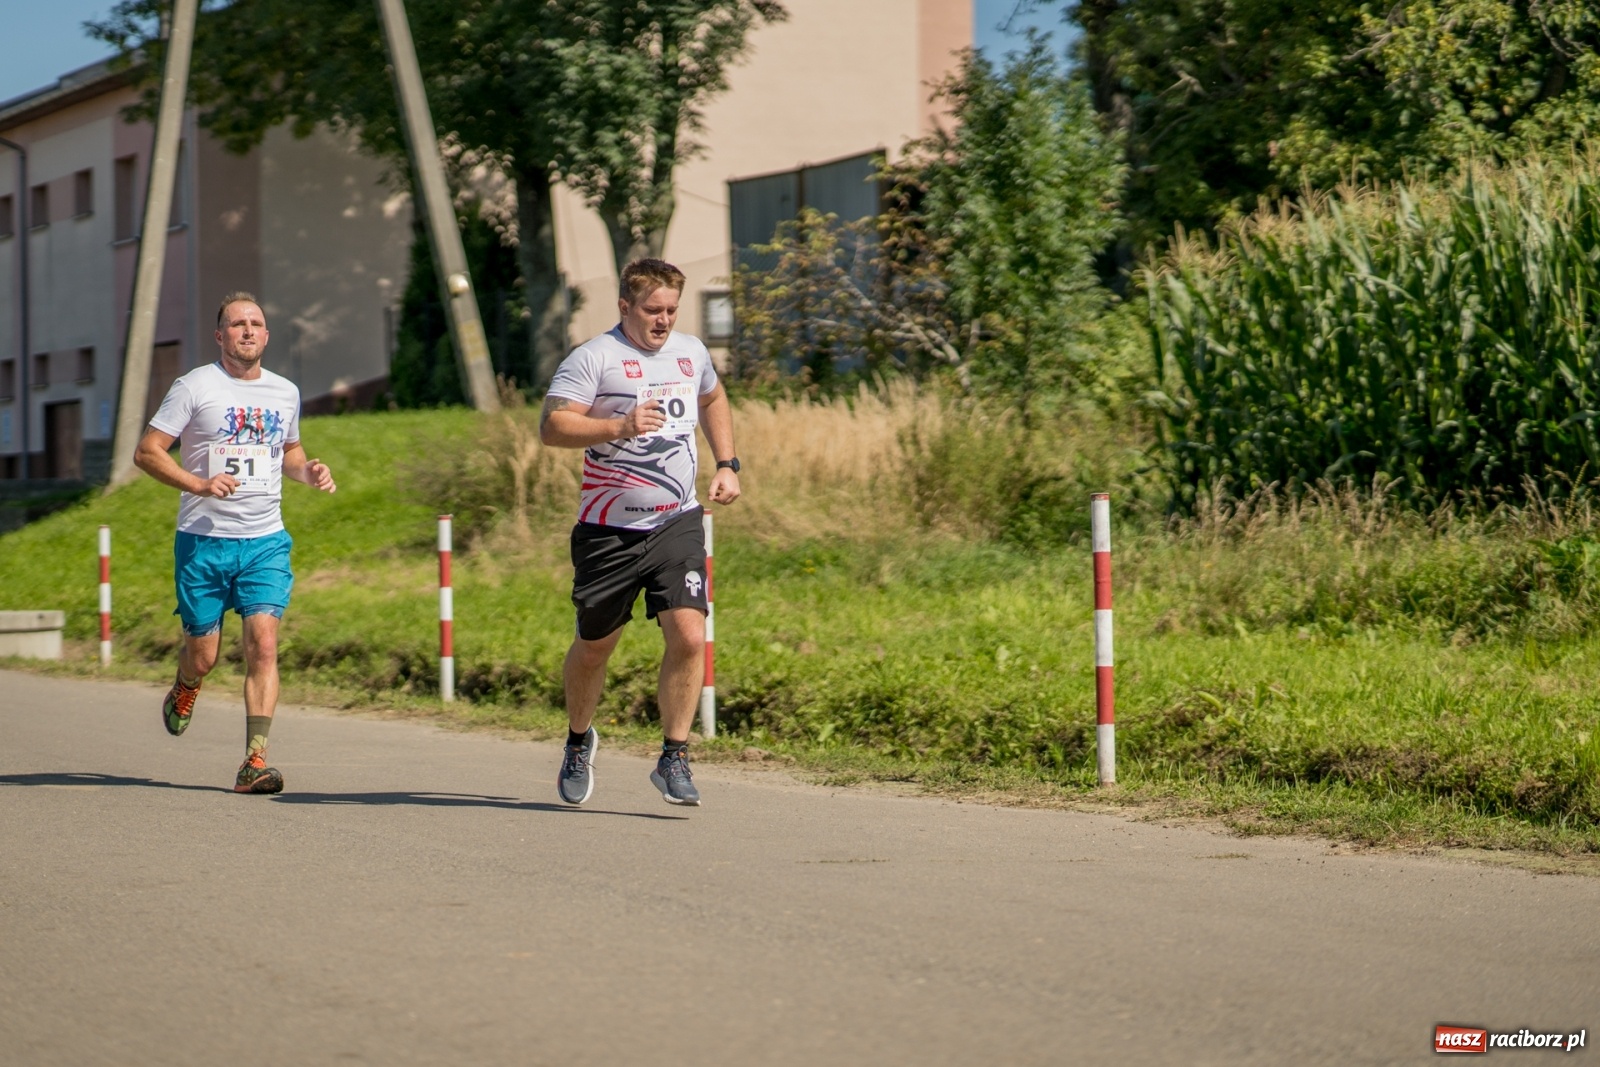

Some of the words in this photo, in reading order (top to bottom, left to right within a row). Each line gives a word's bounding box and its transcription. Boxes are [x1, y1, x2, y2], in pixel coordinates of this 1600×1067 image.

[641, 388, 673, 398] COLOUR
[676, 387, 692, 397] RUN
[214, 447, 248, 457] COLOUR
[252, 447, 268, 457] RUN
[224, 457, 255, 477] 51
